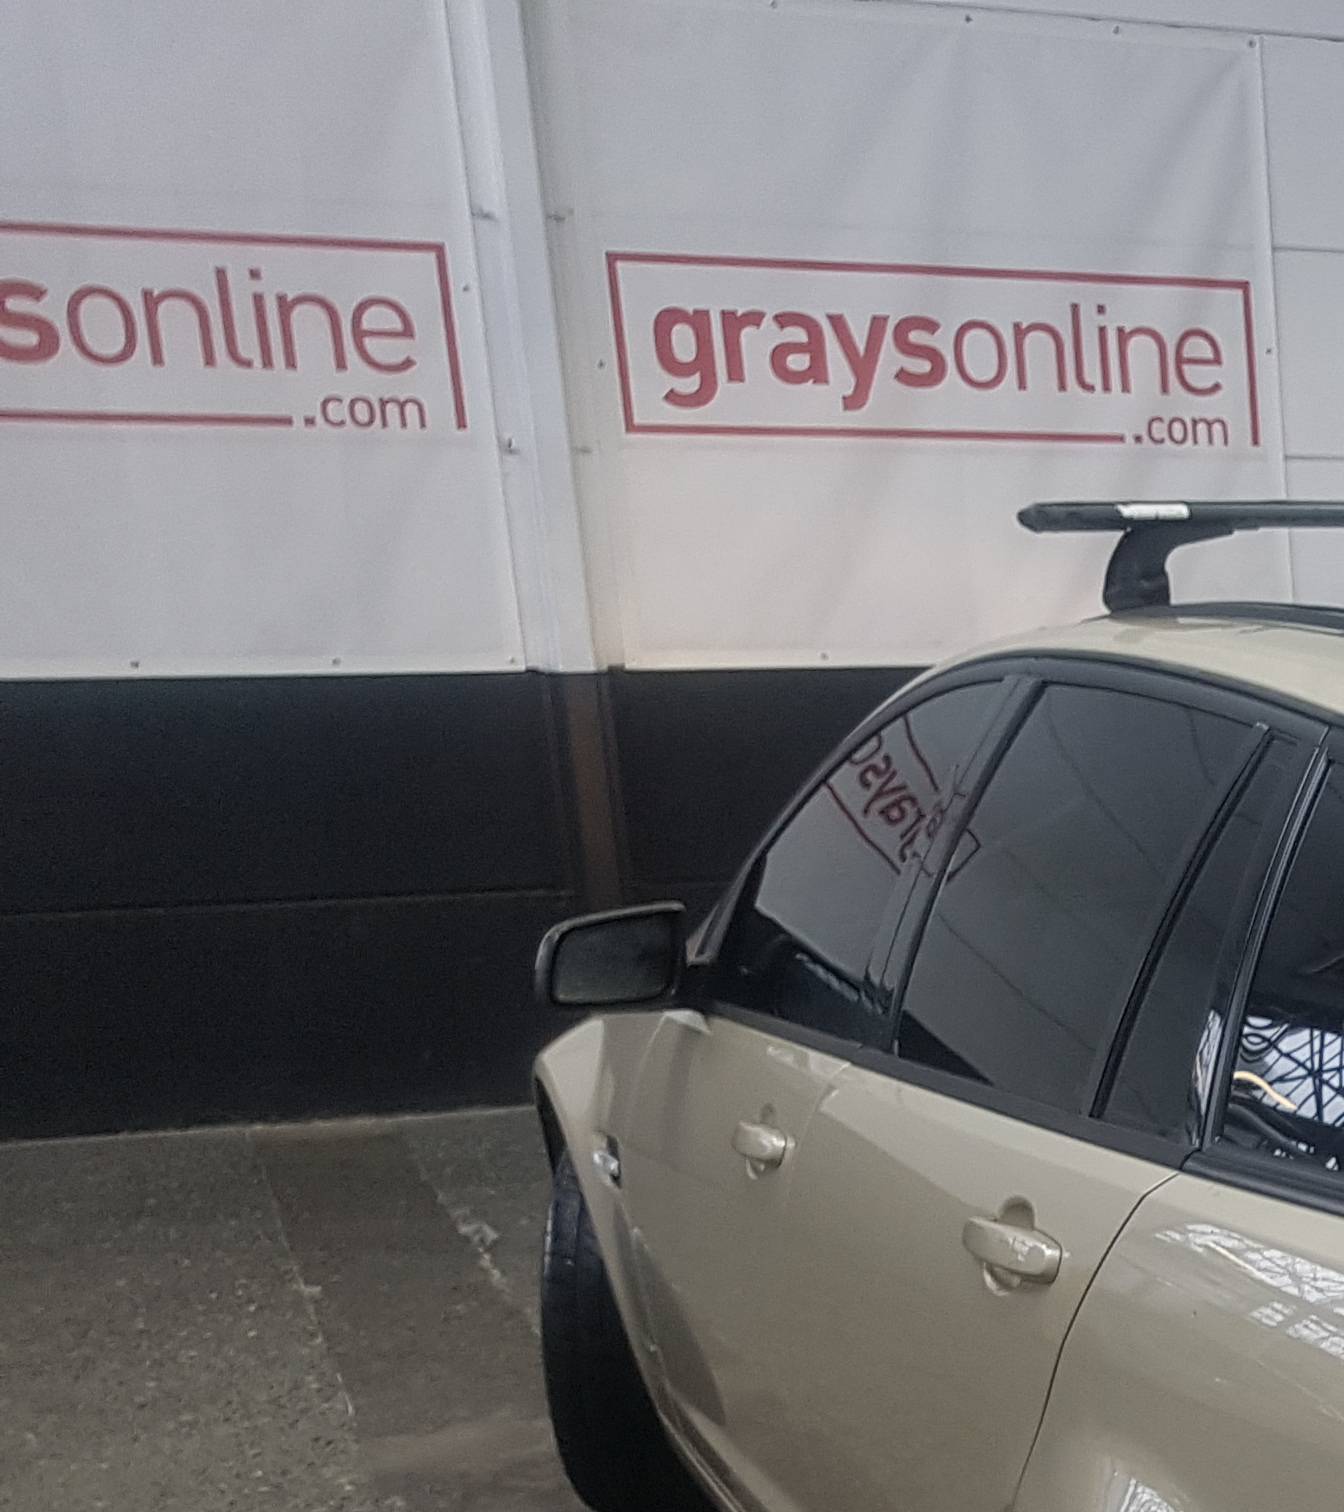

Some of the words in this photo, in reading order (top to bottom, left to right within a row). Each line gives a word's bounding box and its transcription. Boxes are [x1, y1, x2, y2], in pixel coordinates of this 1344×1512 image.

[653, 303, 1224, 411] graysonline
[302, 394, 427, 430] .com
[1131, 410, 1230, 448] .com
